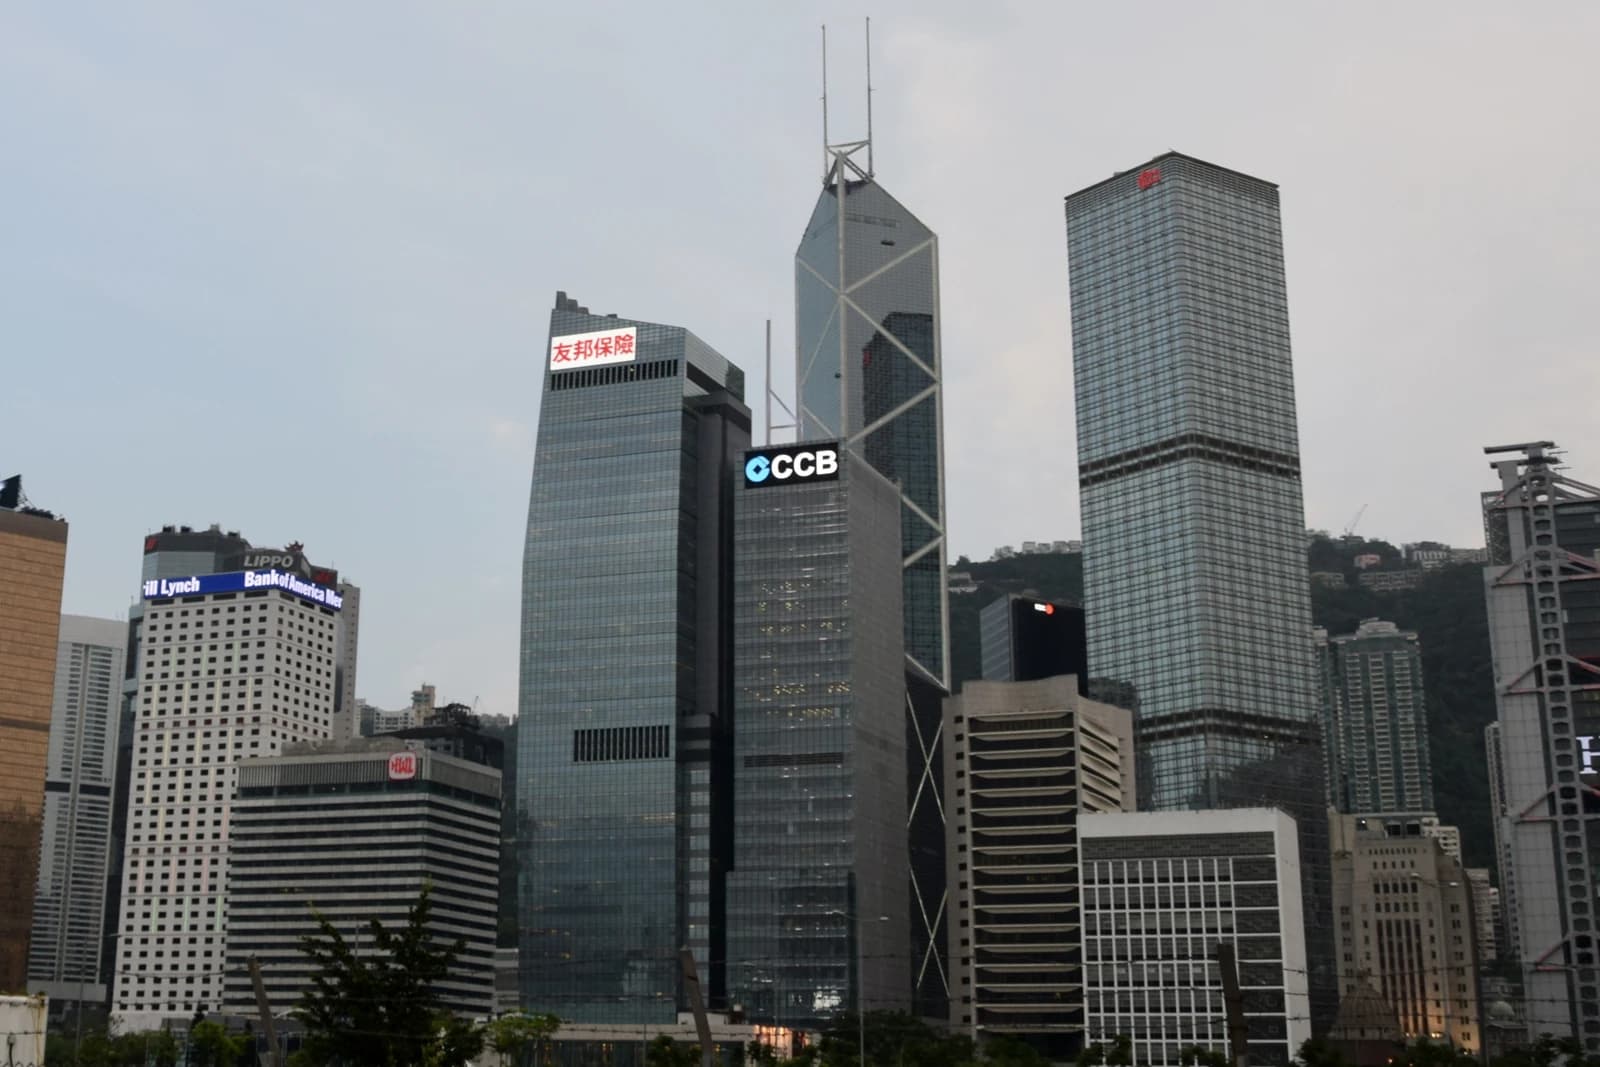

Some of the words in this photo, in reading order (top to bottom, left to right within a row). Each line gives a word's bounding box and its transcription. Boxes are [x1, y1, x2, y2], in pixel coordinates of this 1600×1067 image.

[553, 334, 633, 362] 友邦保險
[771, 450, 838, 479] CCB
[244, 555, 293, 568] LIPPO
[143, 580, 158, 596] ill
[161, 576, 200, 597] Lynch
[244, 569, 279, 587] Bank
[279, 572, 290, 588] of
[289, 575, 325, 602] America
